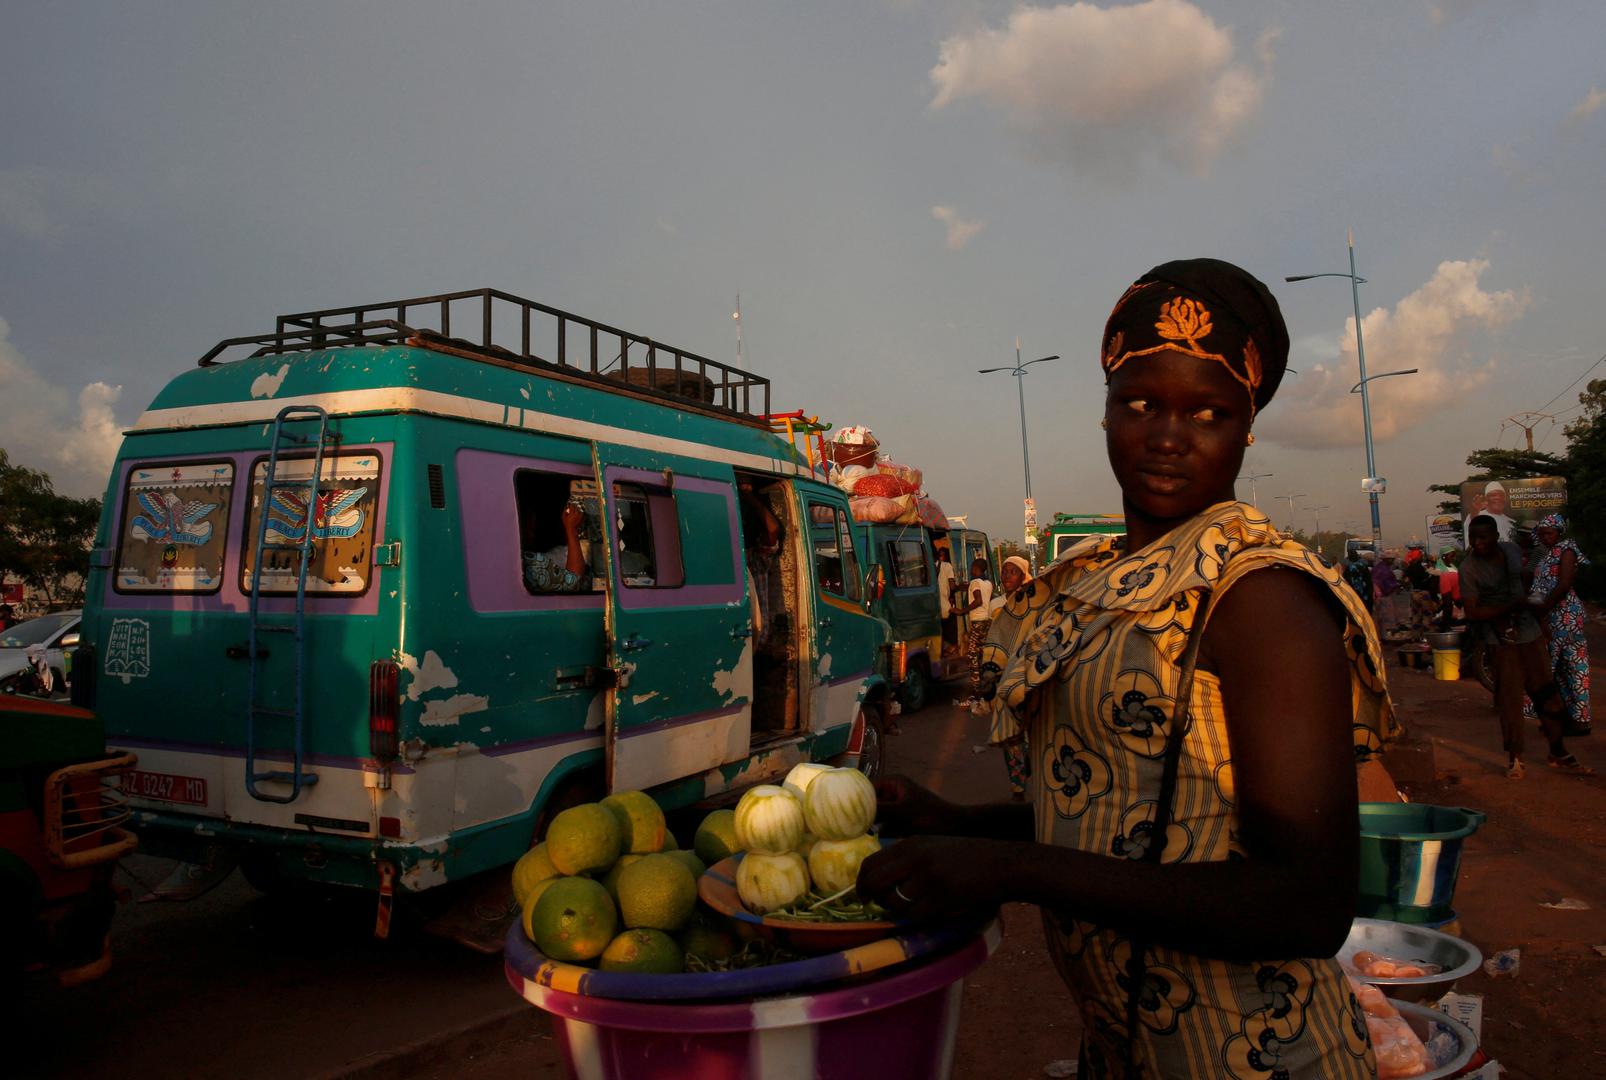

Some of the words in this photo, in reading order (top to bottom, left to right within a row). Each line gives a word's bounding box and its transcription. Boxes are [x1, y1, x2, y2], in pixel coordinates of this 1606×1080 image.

[319, 526, 350, 538] LIBERTY
[143, 774, 174, 798] 0247
[186, 779, 204, 801] MD
